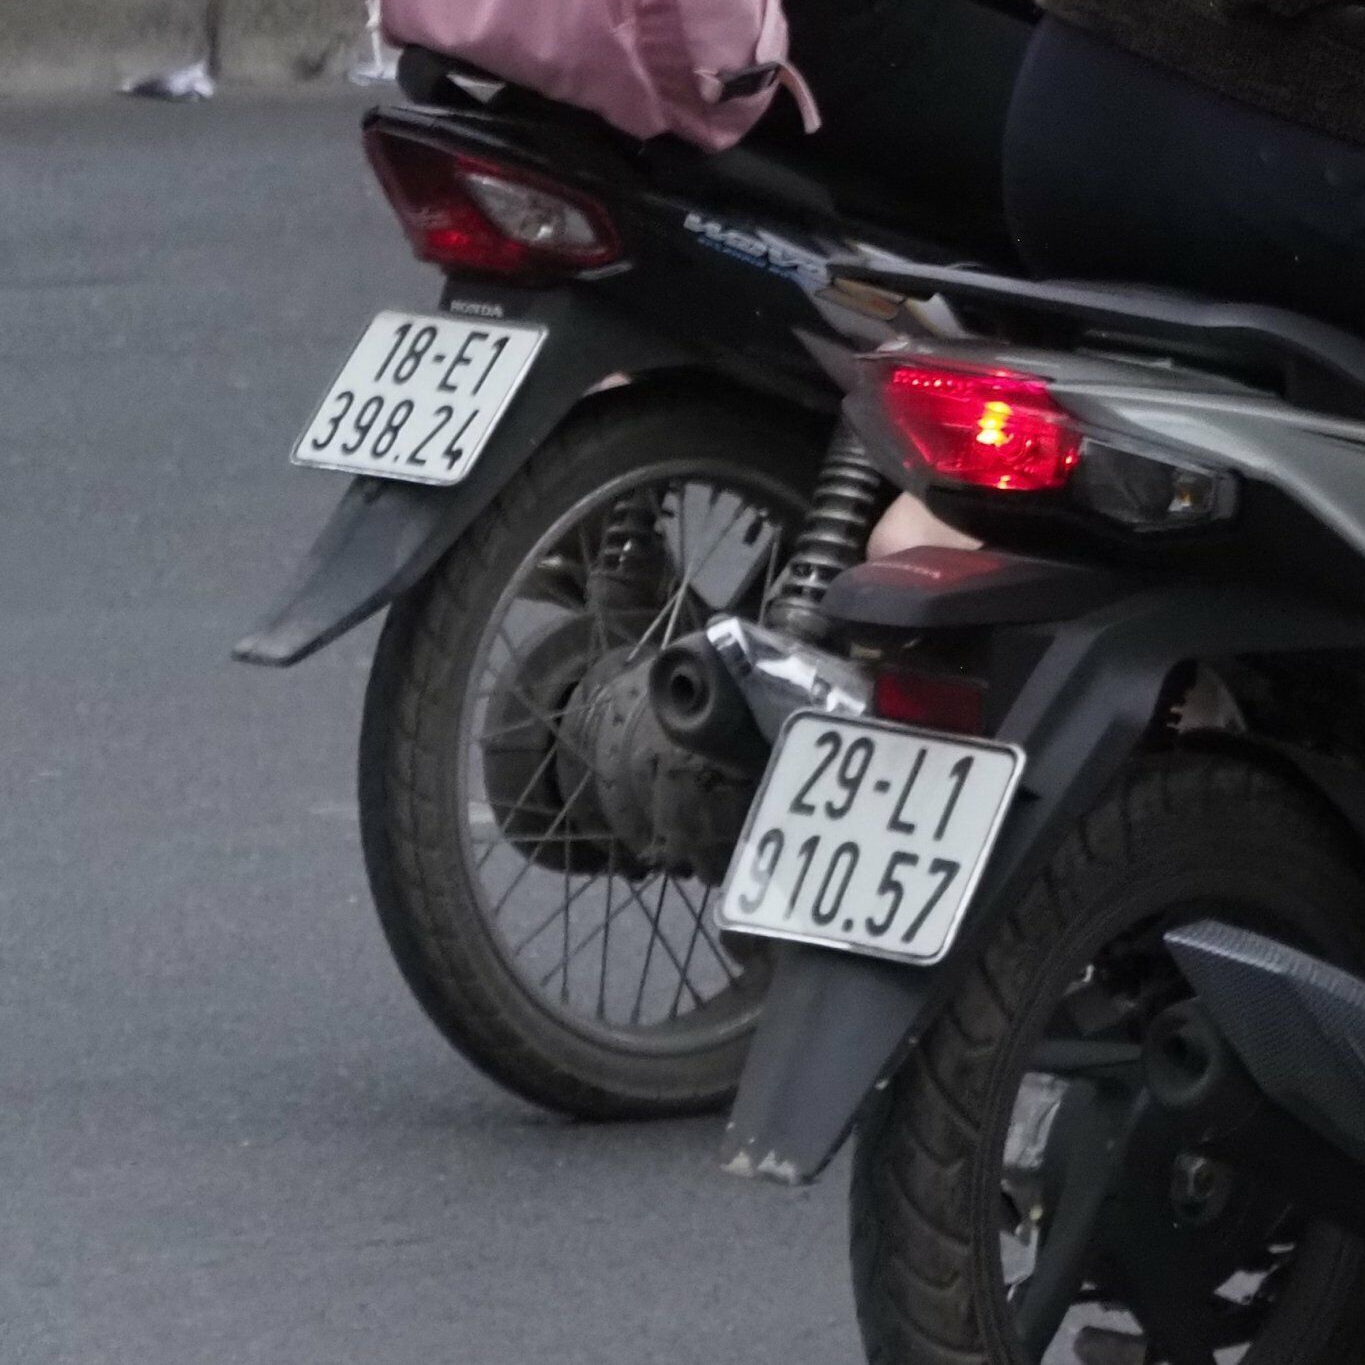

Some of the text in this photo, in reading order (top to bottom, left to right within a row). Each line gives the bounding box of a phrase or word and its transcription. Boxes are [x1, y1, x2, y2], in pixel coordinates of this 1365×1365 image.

[374, 322, 510, 397] 18-E1
[311, 390, 480, 471] 398.24
[789, 730, 975, 842] 29-L1
[738, 828, 961, 943] 910.57
